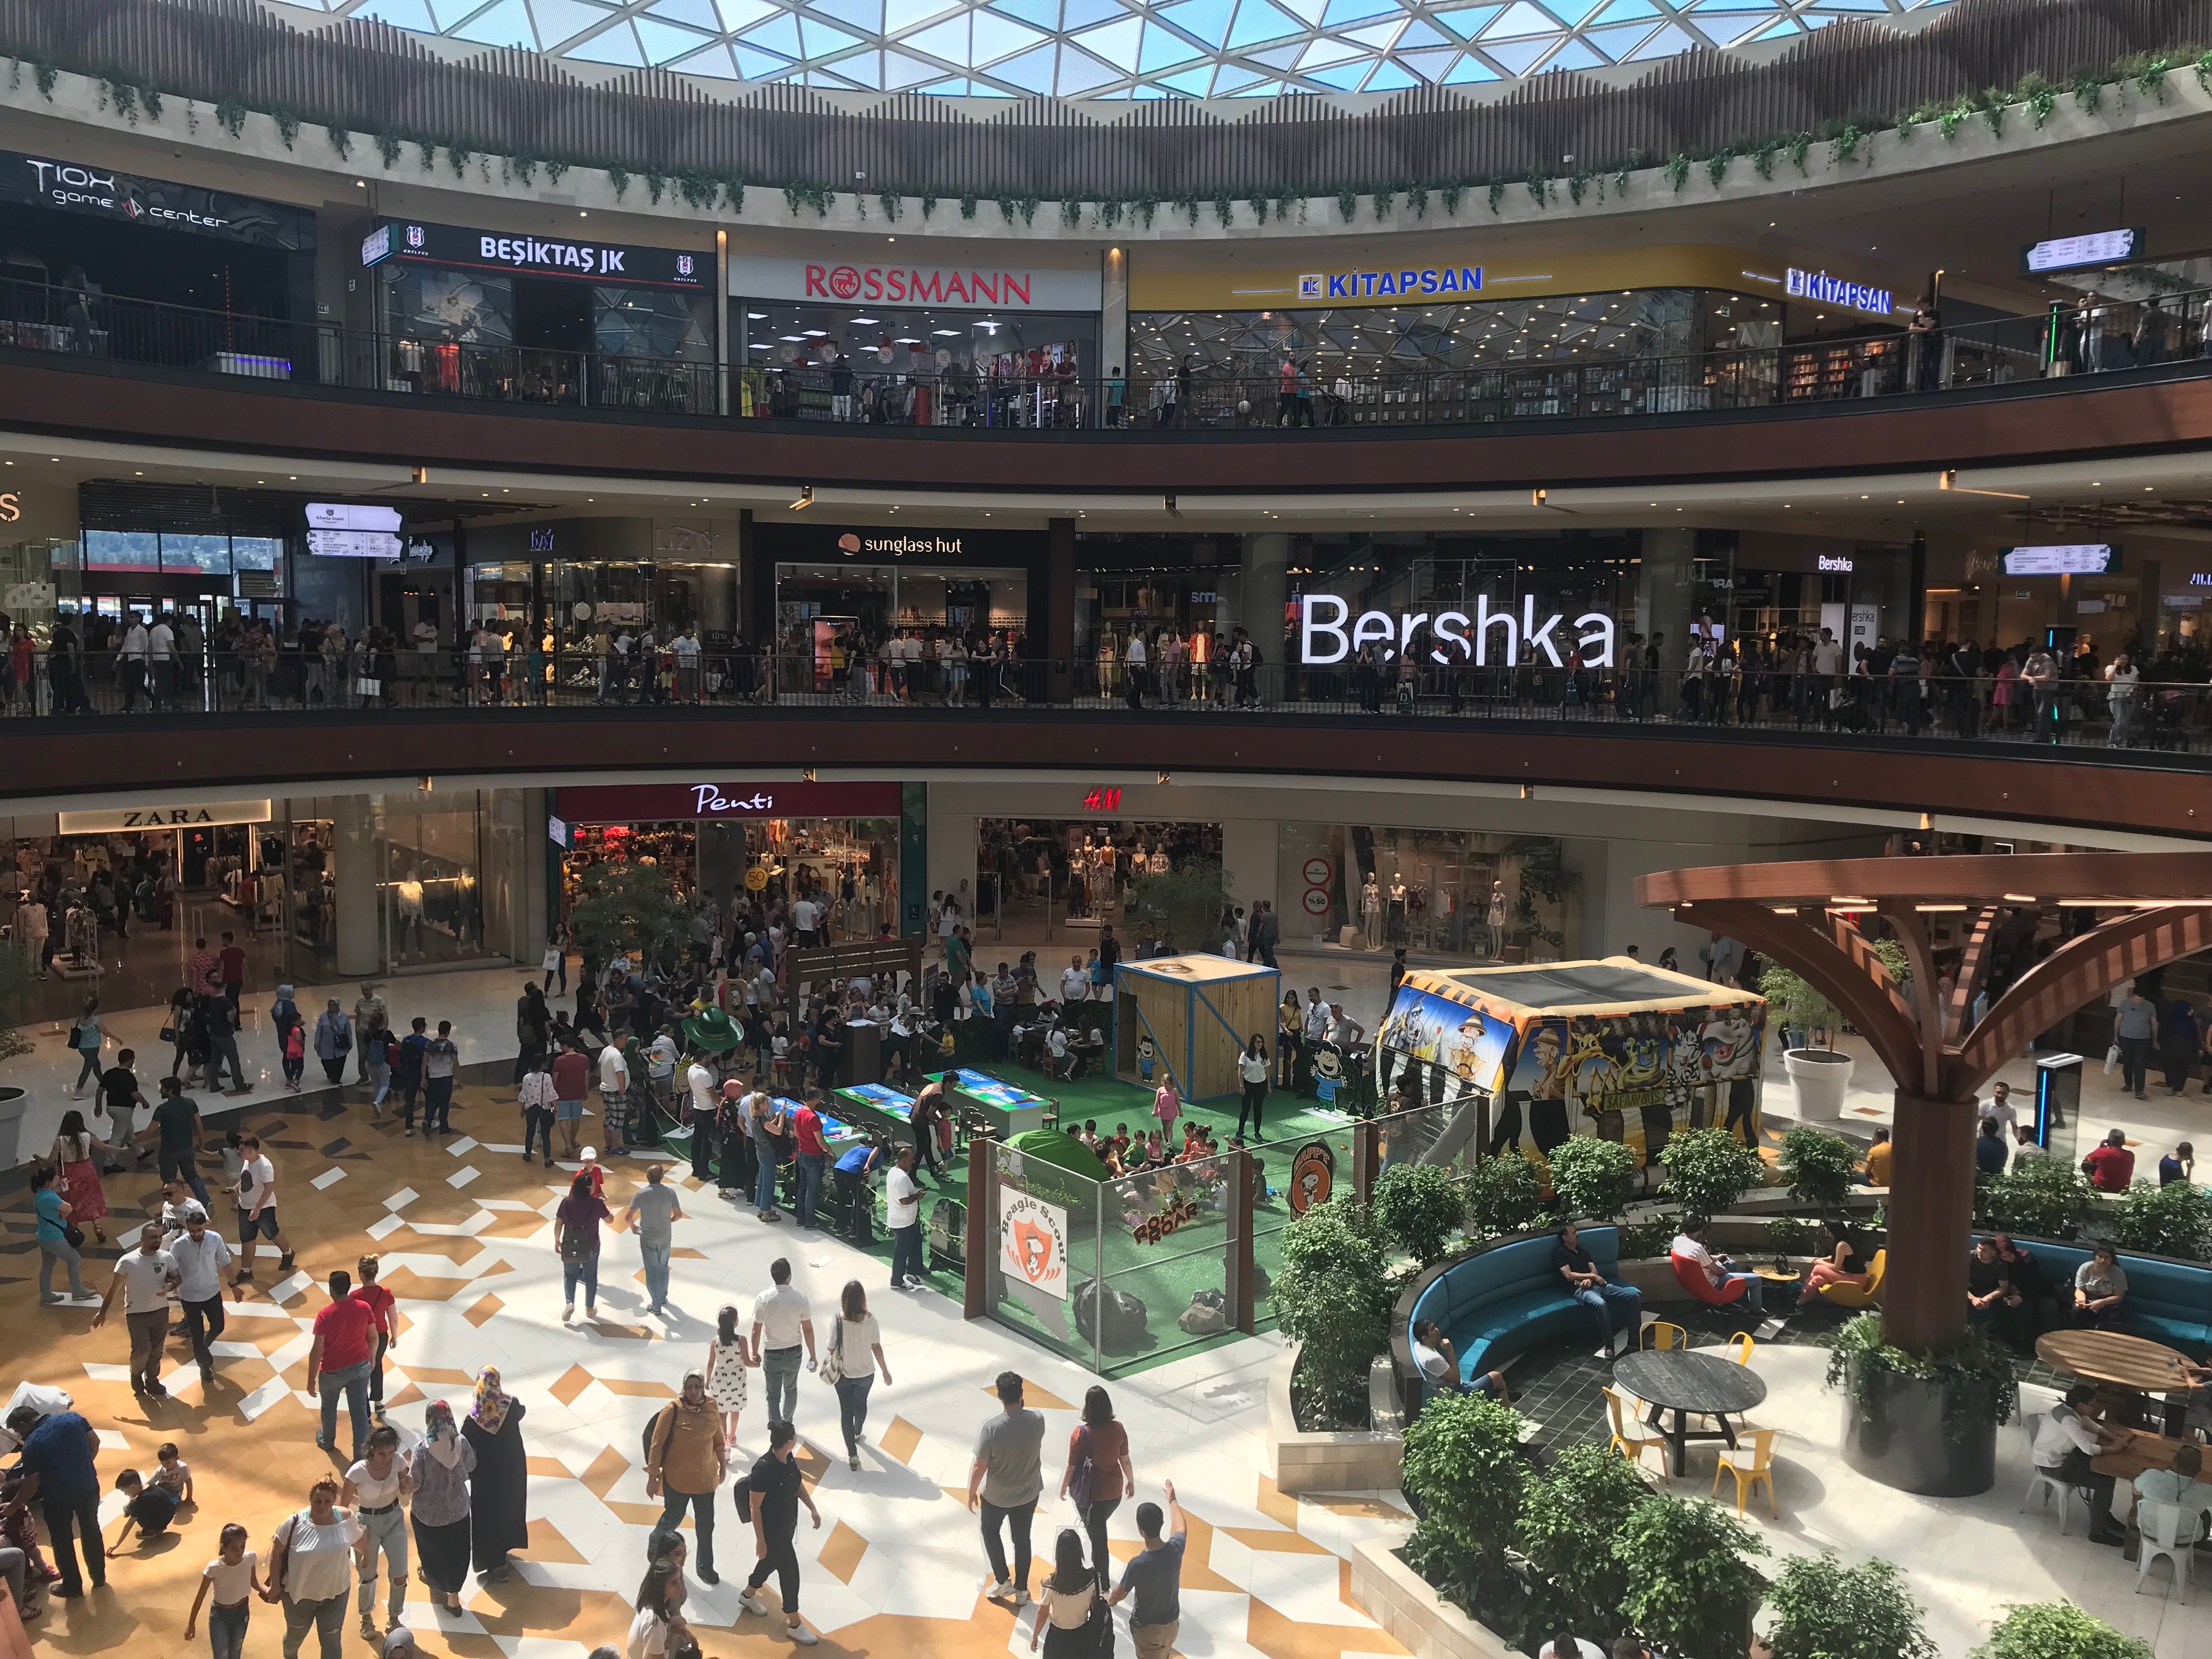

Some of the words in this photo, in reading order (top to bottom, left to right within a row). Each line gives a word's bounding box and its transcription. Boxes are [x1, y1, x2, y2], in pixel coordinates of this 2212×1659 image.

[27, 160, 115, 192] TIOX
[52, 190, 114, 208] game
[150, 210, 228, 227] center
[481, 236, 594, 272] BEŞİKTAŞ
[600, 250, 625, 273] JK
[806, 264, 1030, 304] ROSSMANN
[1328, 267, 1482, 298] KİTAPSAN
[1805, 269, 1892, 314] KİTAPSAN
[865, 536, 933, 556] sunglass
[936, 537, 962, 553] hut
[1819, 555, 1853, 571] Bershka
[1302, 594, 1614, 668] Bershka
[1852, 610, 1875, 622] ershka
[691, 785, 772, 814] Penti
[1083, 787, 1122, 812] H&M
[124, 808, 215, 827] ZARA
[748, 871, 765, 882] 50
[1294, 1147, 1330, 1176] HAPPY
[1001, 1197, 1037, 1237] Beagle
[1040, 1205, 1066, 1265] Scout
[1148, 1201, 1198, 1246] ROAR
